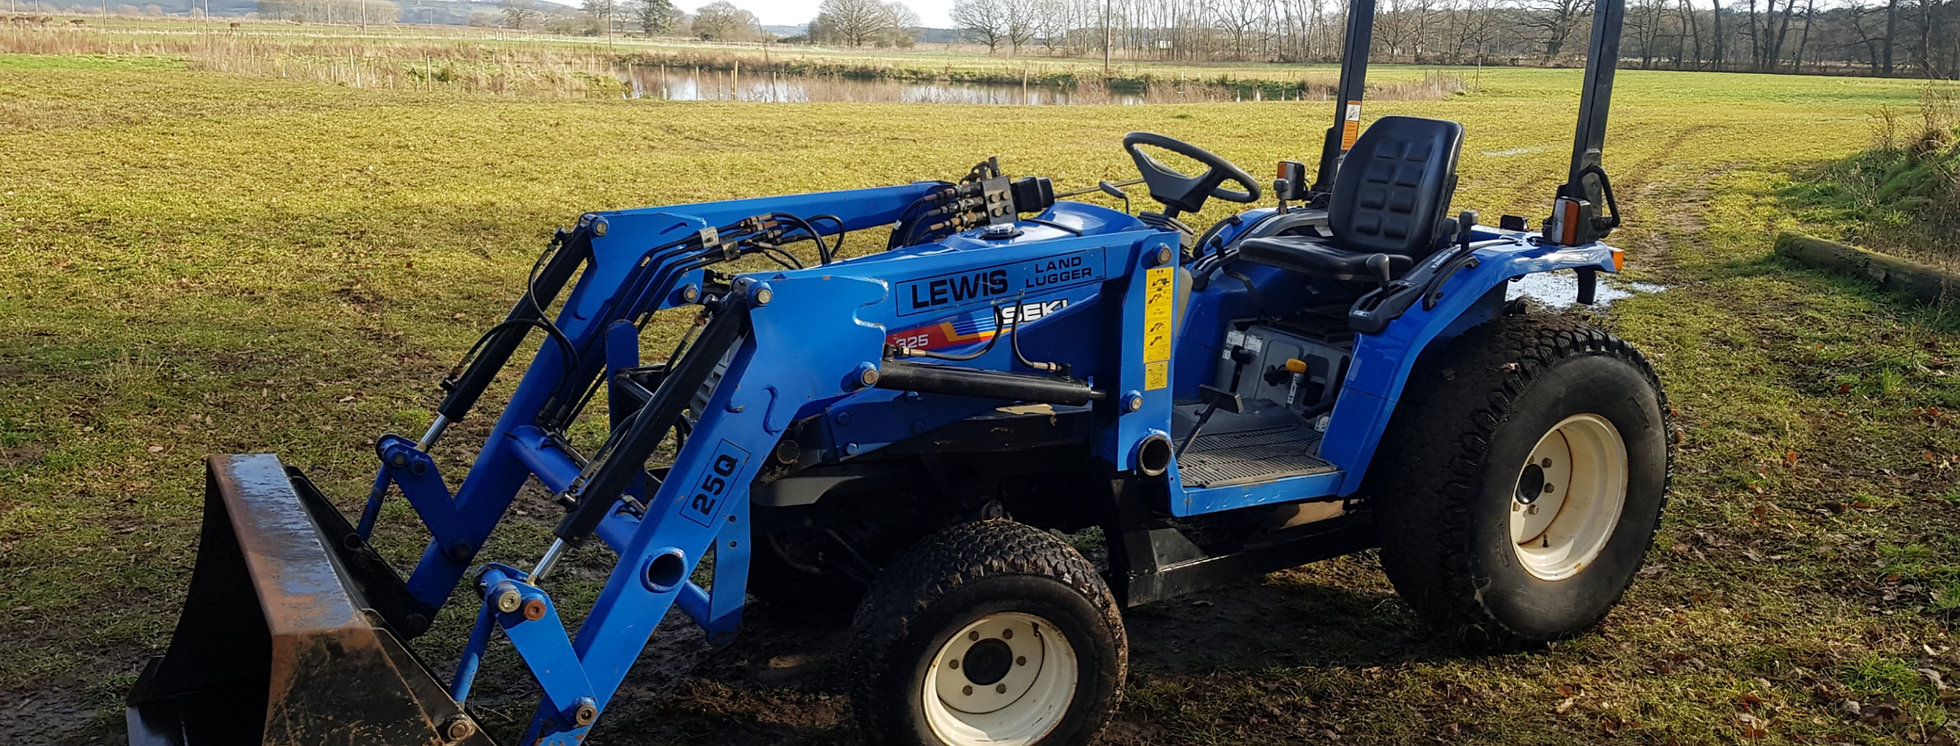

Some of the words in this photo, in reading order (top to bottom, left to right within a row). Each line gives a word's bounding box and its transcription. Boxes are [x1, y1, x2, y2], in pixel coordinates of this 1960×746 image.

[1035, 256, 1082, 273] LAND
[911, 269, 1008, 309] LEWIS
[1025, 267, 1092, 289] LUGGER
[895, 333, 929, 349] 325
[691, 454, 739, 516] 25Q
